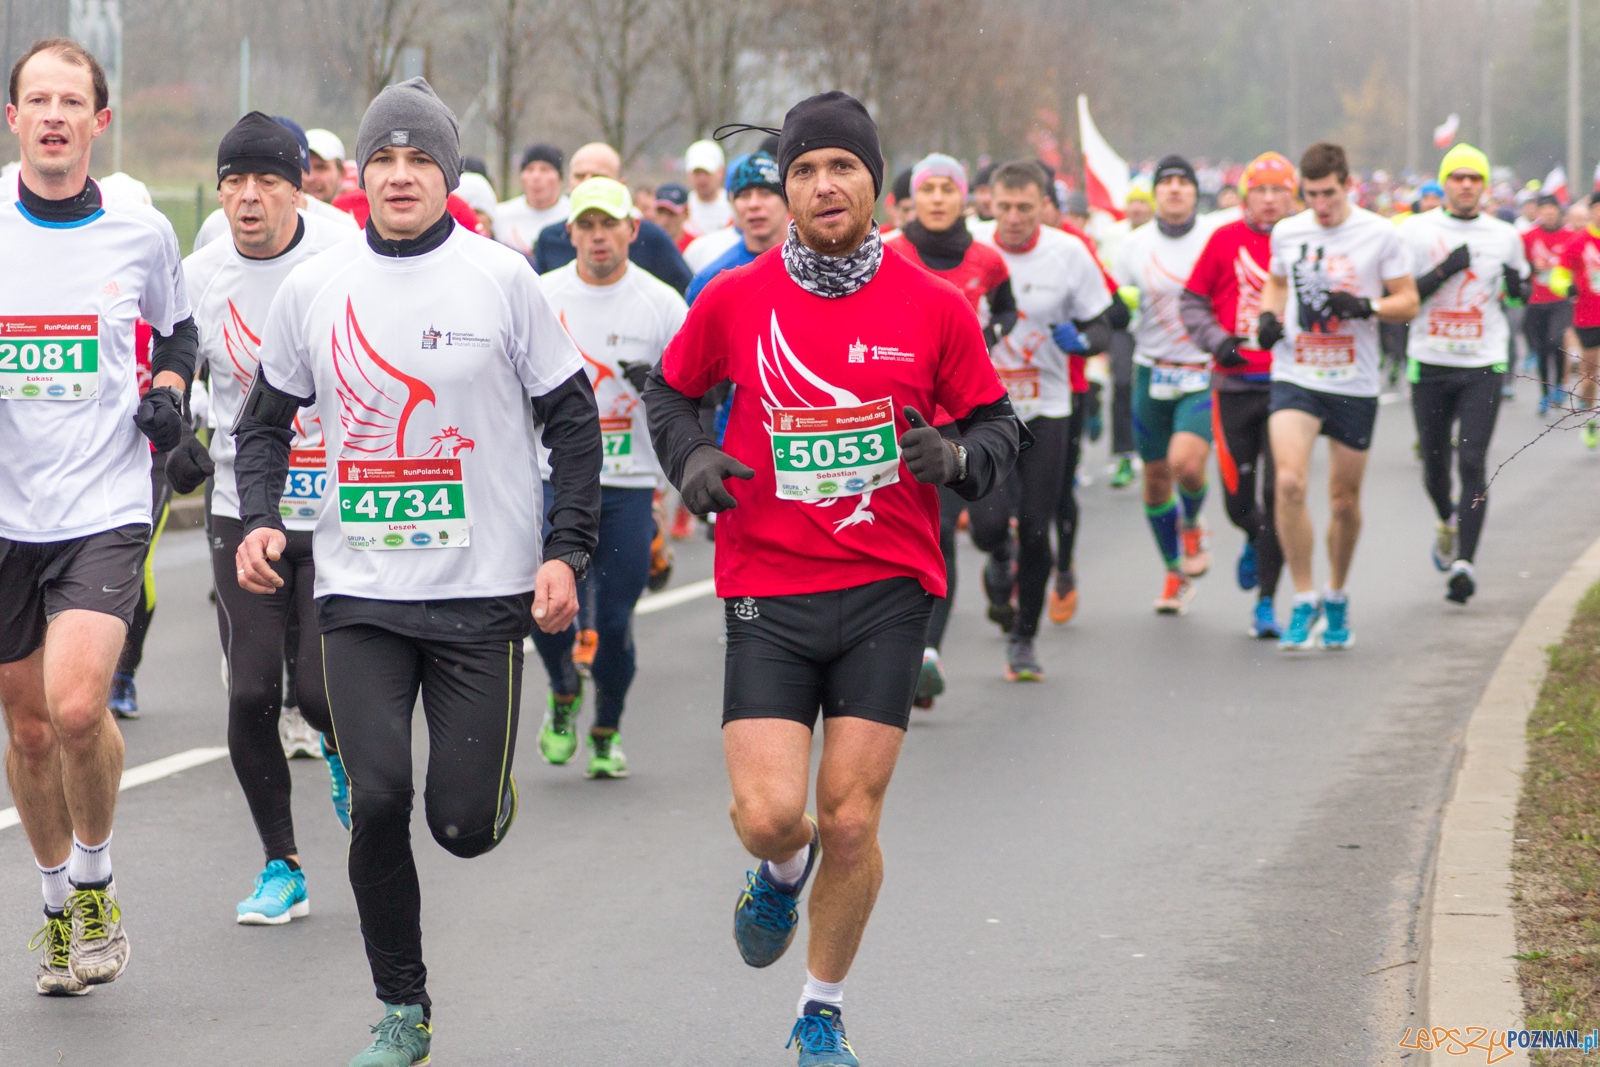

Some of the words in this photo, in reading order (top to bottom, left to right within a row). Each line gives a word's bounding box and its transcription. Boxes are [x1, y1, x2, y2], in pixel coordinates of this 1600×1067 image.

[445, 332, 453, 346] 1
[0, 343, 82, 370] 2081
[836, 411, 886, 424] RunPoland.org
[776, 448, 784, 458] C
[789, 434, 884, 468] 5053
[403, 468, 454, 476] RunPoland.org
[816, 470, 857, 480] Sebastian
[342, 499, 351, 510] C
[355, 488, 452, 519] 4734
